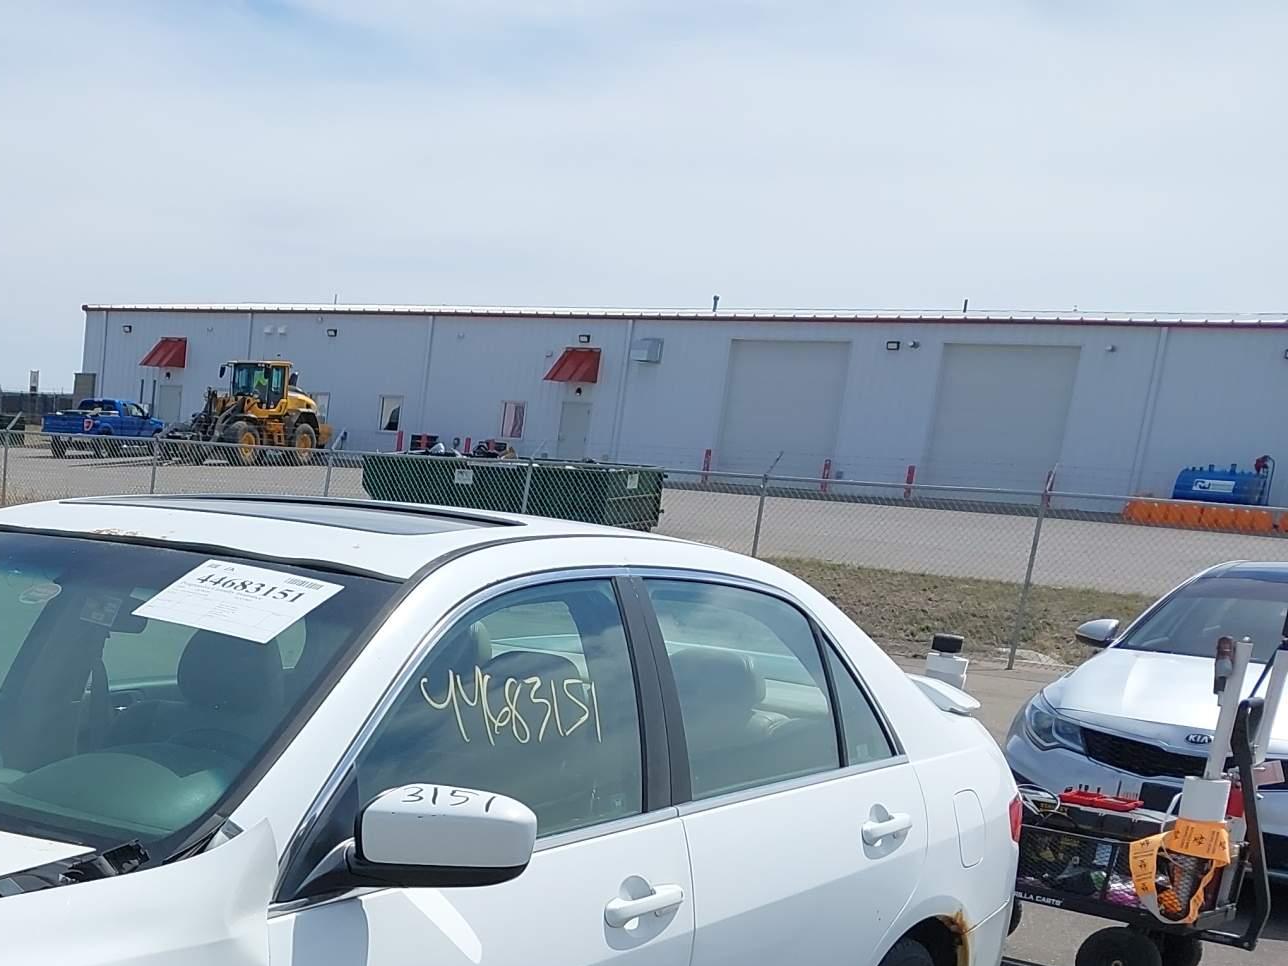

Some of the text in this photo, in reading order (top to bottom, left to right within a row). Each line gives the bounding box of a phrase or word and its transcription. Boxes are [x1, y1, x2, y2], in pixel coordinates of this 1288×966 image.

[196, 573, 305, 603] 44683151
[419, 665, 602, 747] 44683151
[400, 786, 496, 814] 3151
